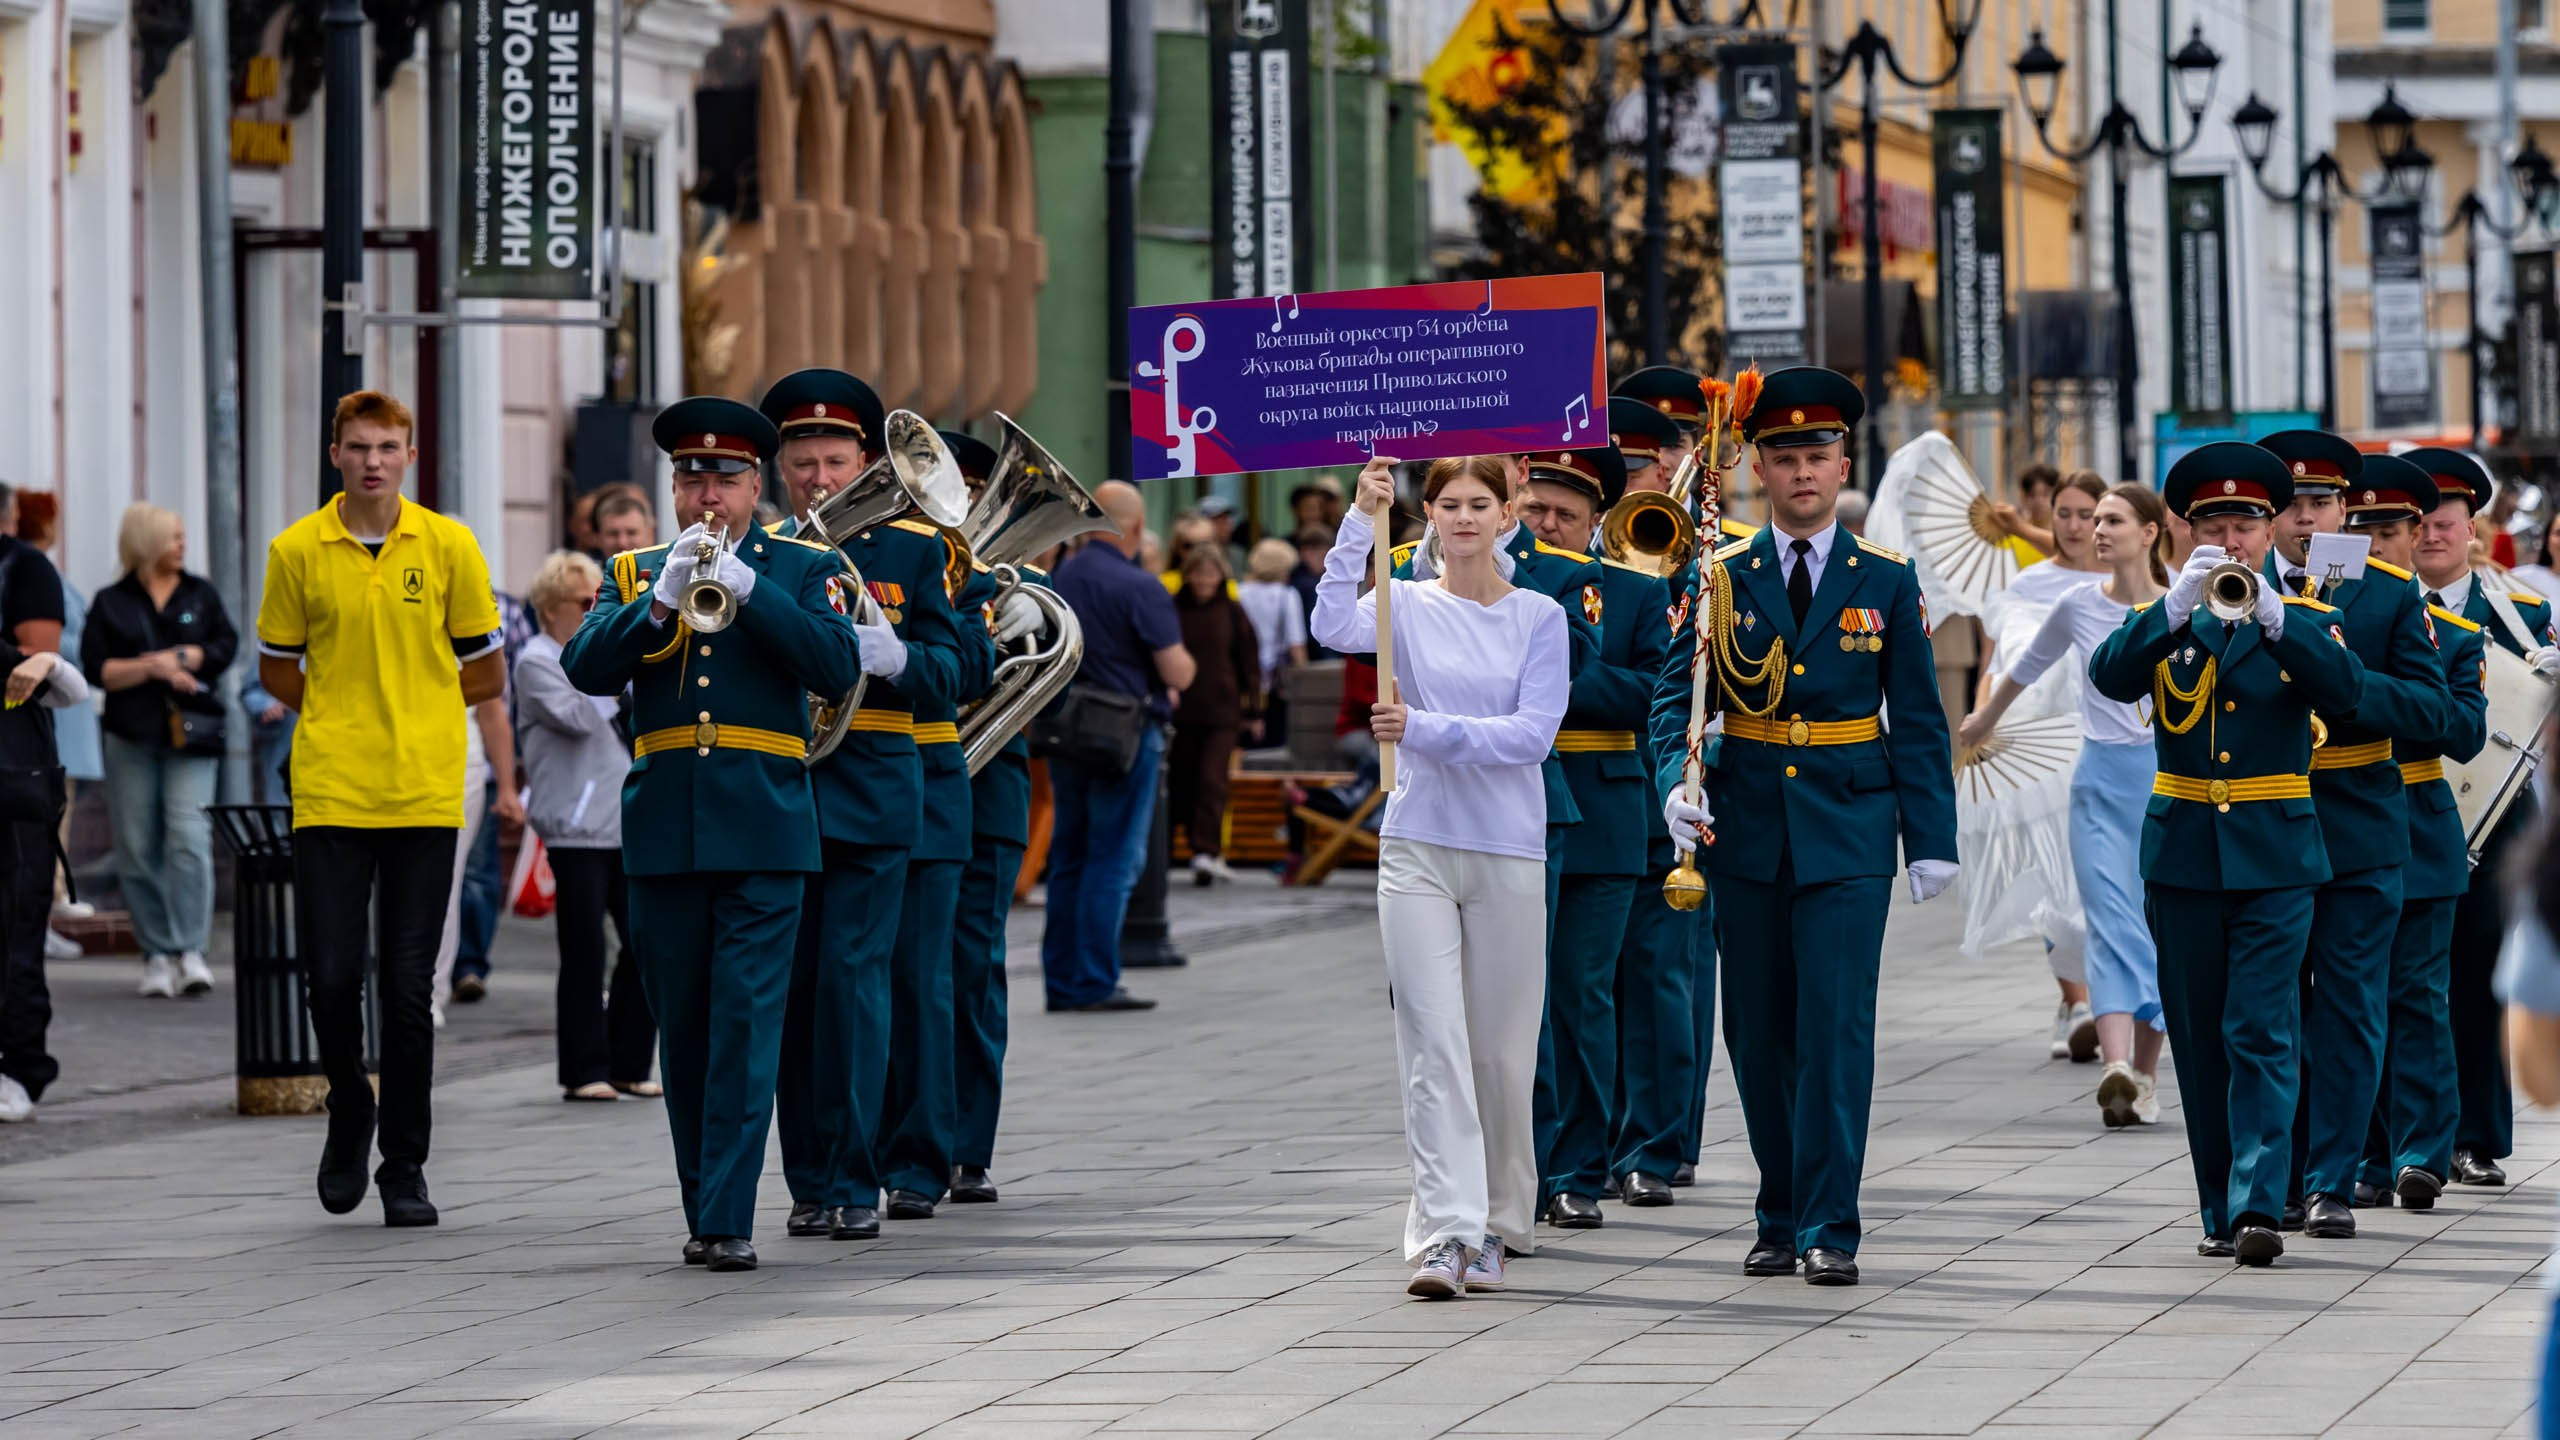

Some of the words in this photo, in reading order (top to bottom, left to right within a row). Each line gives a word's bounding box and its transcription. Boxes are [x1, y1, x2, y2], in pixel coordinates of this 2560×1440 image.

[474, 48, 492, 208] профессиональные
[500, 0, 539, 267] НИЖЕГОРОД
[546, 10, 580, 269] ОПОЛЧЕНИЕ
[1230, 50, 1255, 258] ФОРМИРОВАНИЯ
[472, 210, 489, 266] Новые
[1255, 327, 1335, 350] Военный
[1339, 324, 1413, 347] оркестр
[1444, 312, 1509, 339] ордена
[1952, 191, 1979, 395] НИЖЕГОРОДСКОЕ
[1980, 252, 2004, 395] ОПОЛЧЕНИЕ
[1240, 355, 1315, 378] Жукова
[1318, 345, 1393, 373] бригады
[1397, 342, 1525, 366] оперативного
[1259, 407, 1319, 427] округа
[1323, 401, 1375, 419] войск
[1380, 389, 1510, 417] национальной
[1264, 378, 1368, 399] назначения
[1373, 368, 1508, 394] Приволжского
[1335, 420, 1408, 446] гвардии
[1412, 419, 1439, 437] РФ
